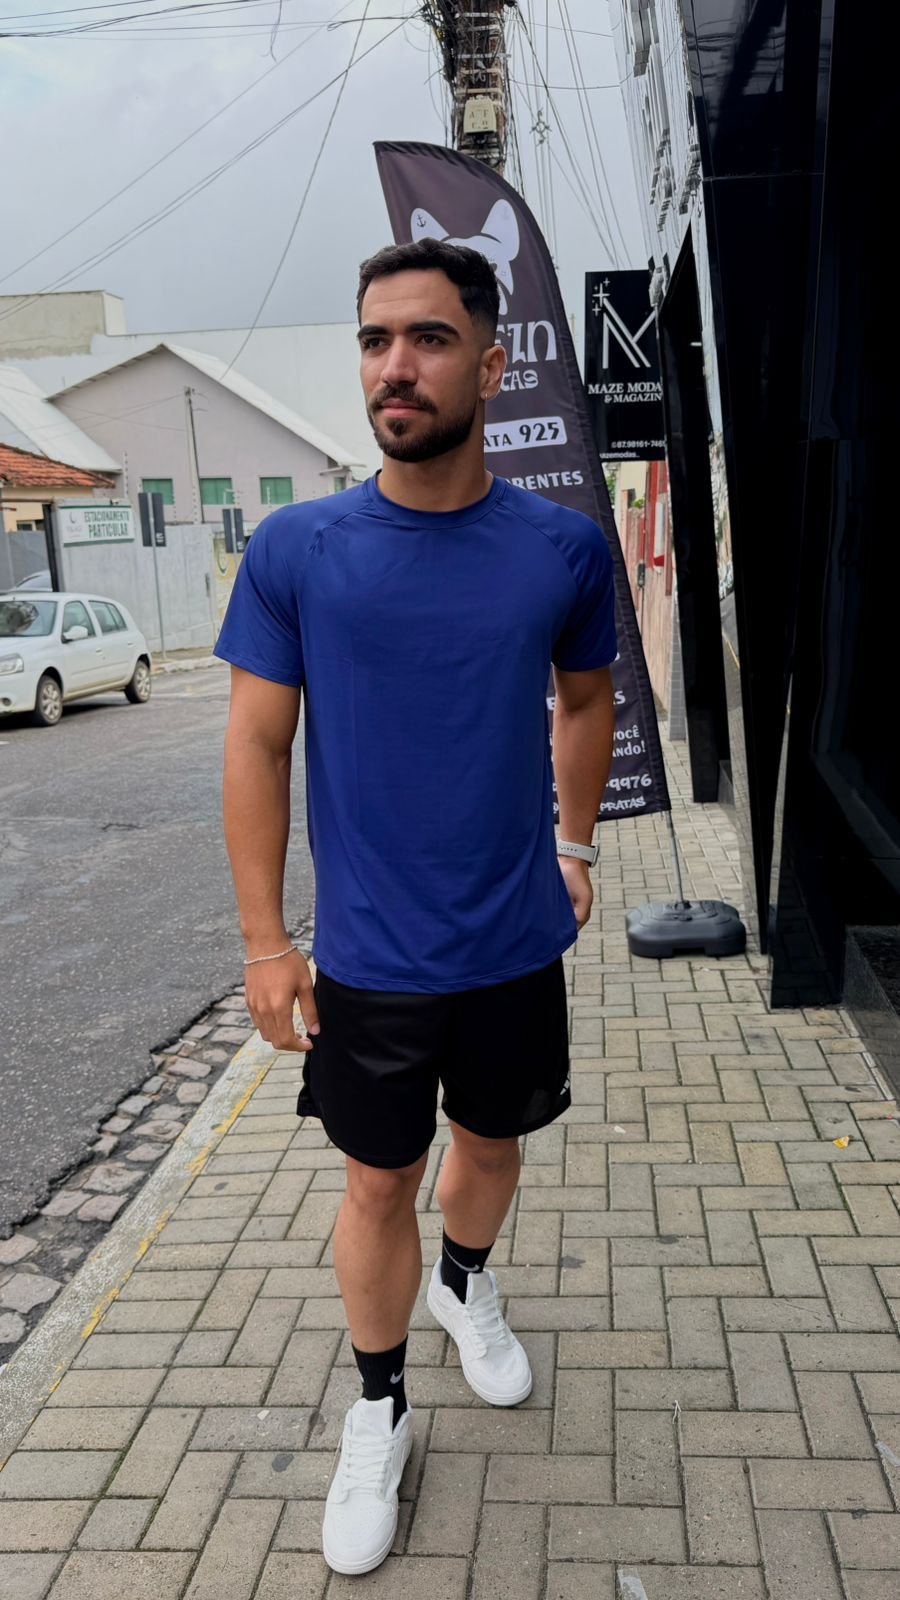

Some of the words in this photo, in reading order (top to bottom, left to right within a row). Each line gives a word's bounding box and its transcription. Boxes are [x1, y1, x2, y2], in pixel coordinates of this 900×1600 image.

[588, 383, 624, 394] MAZE
[519, 422, 559, 443] 925
[505, 470, 584, 490] RENTES
[88, 523, 129, 538] PARTICULAR
